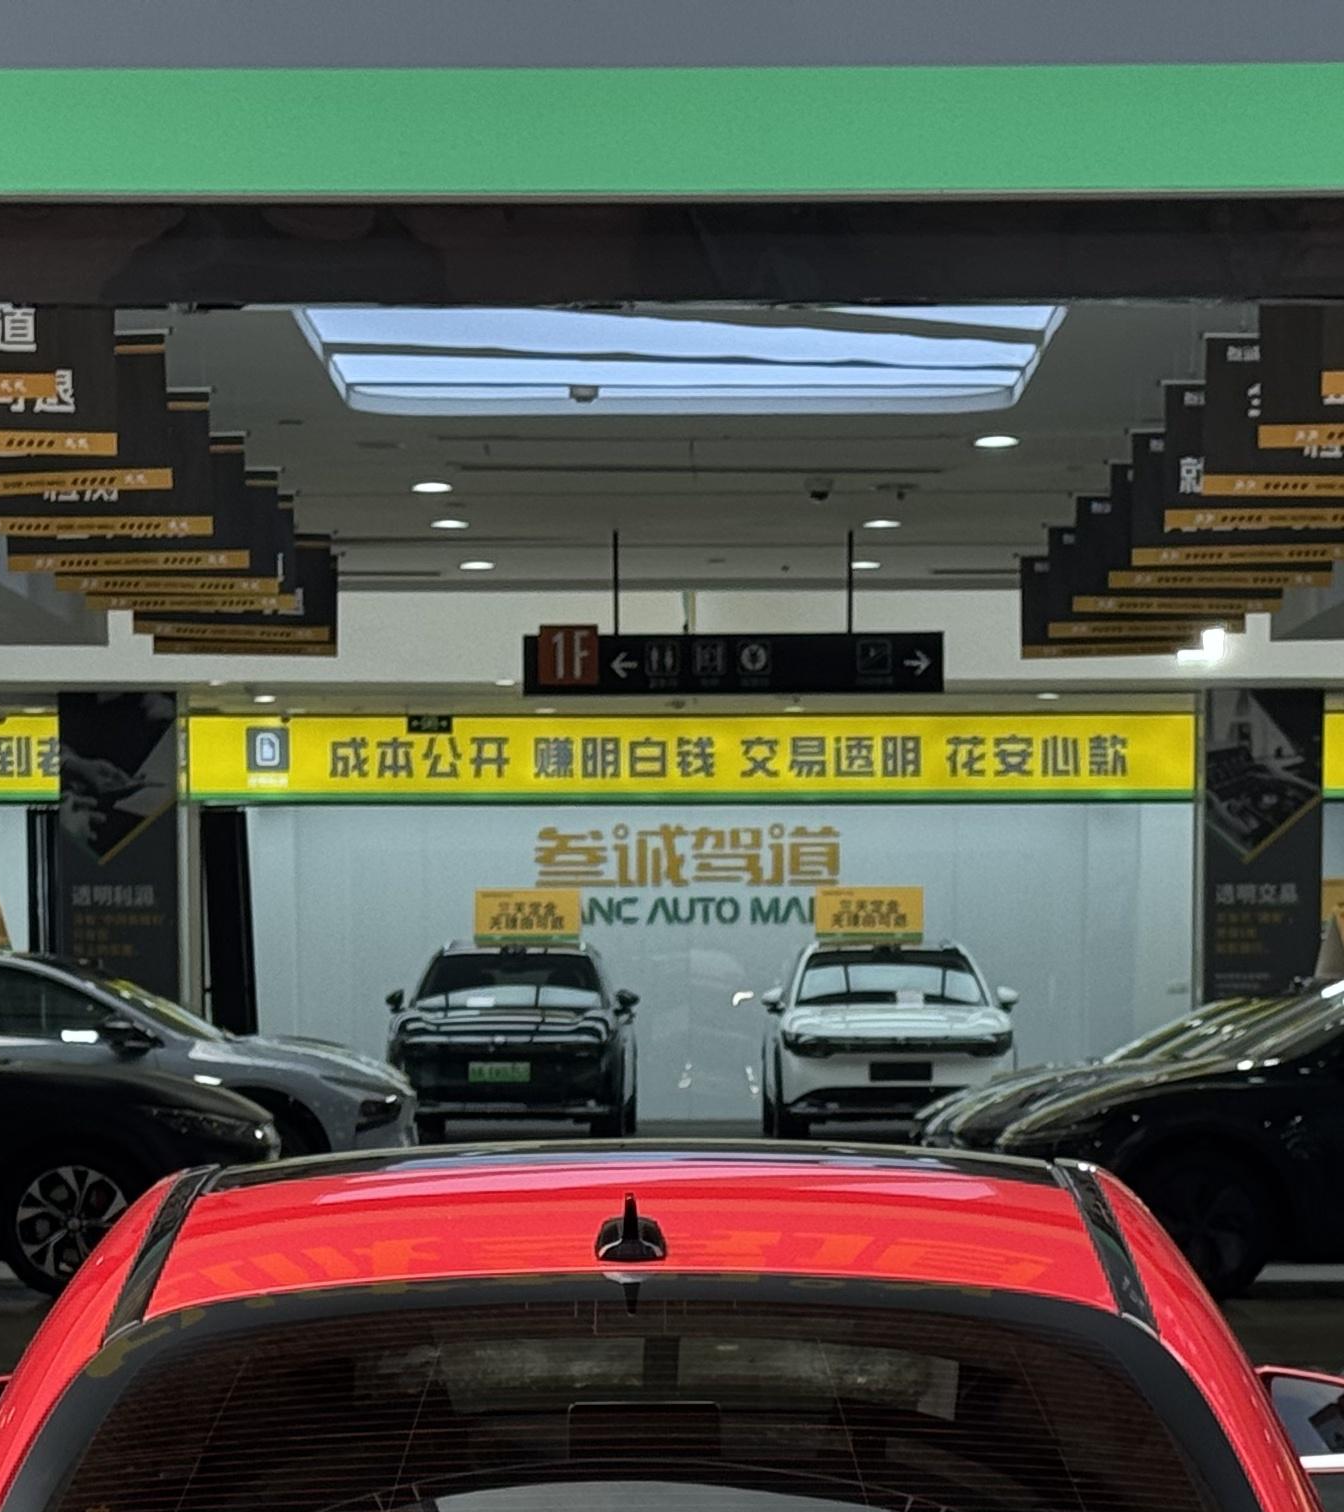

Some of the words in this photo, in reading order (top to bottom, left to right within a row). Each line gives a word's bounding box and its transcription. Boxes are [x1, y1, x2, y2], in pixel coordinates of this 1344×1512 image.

[551, 628, 591, 682] 1F
[328, 736, 511, 779] 成本公开
[533, 736, 716, 779] 赚明白钱
[739, 735, 923, 778] 交易透明
[533, 822, 842, 888] 叁诚驾道
[646, 896, 741, 926] AUTO
